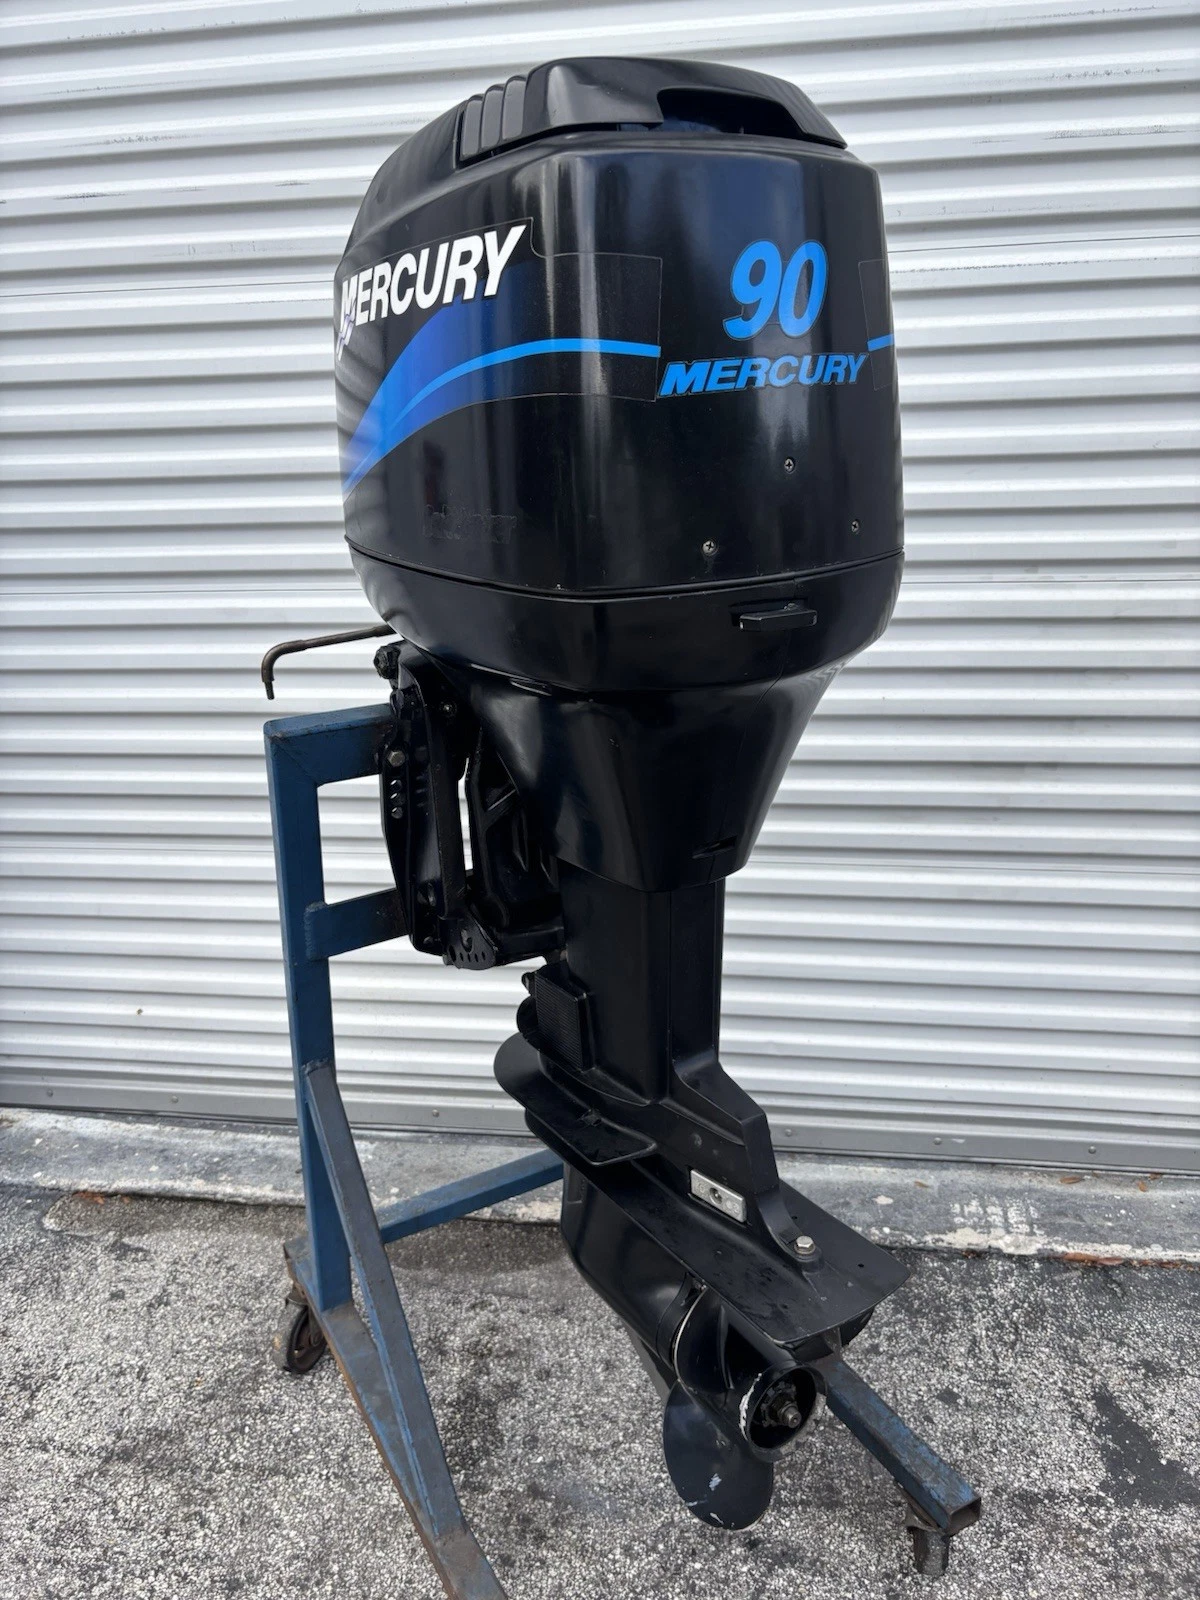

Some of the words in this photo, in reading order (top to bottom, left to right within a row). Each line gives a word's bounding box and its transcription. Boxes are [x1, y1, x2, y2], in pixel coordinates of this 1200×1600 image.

[337, 224, 527, 360] MERCURY
[723, 240, 827, 339] 90
[659, 353, 867, 397] MERCURY
